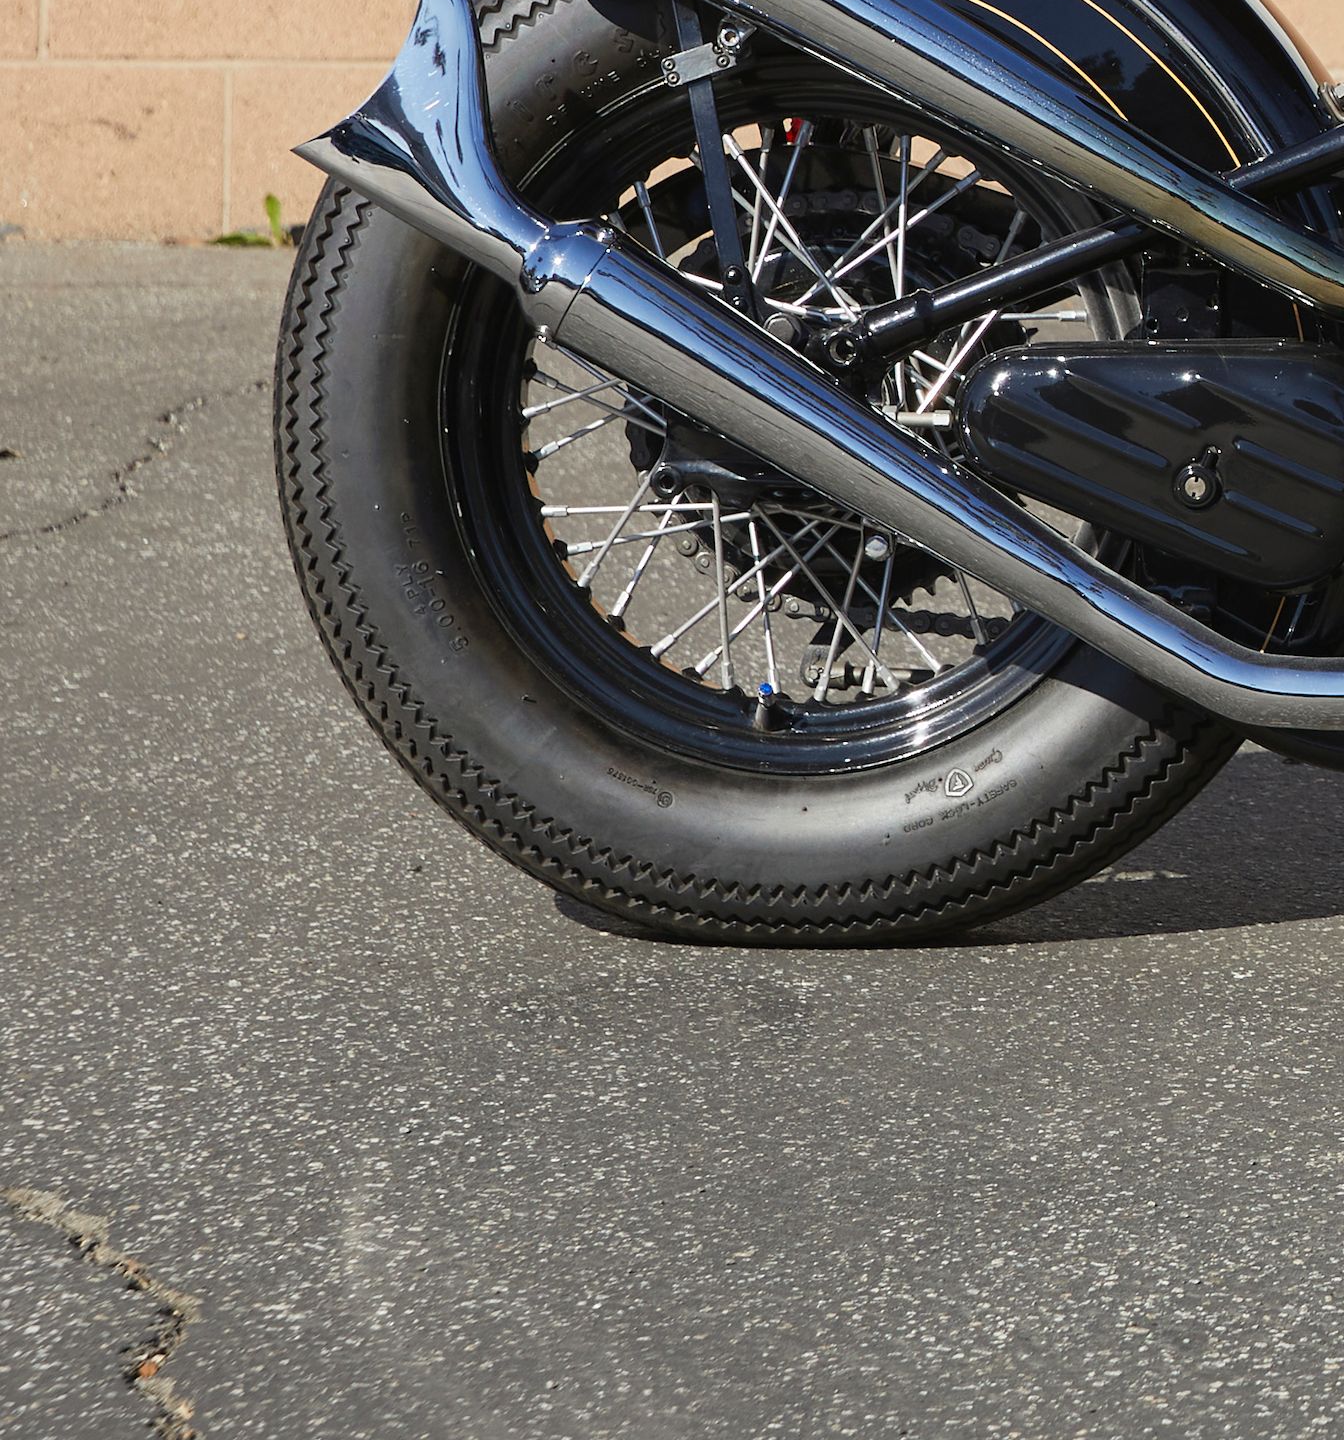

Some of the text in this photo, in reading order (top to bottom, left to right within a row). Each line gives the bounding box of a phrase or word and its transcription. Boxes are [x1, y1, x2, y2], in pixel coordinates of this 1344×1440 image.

[394, 564, 426, 615] 4 PLY
[401, 512, 469, 651] 5.00-16 71P
[903, 817, 934, 833] CORD
